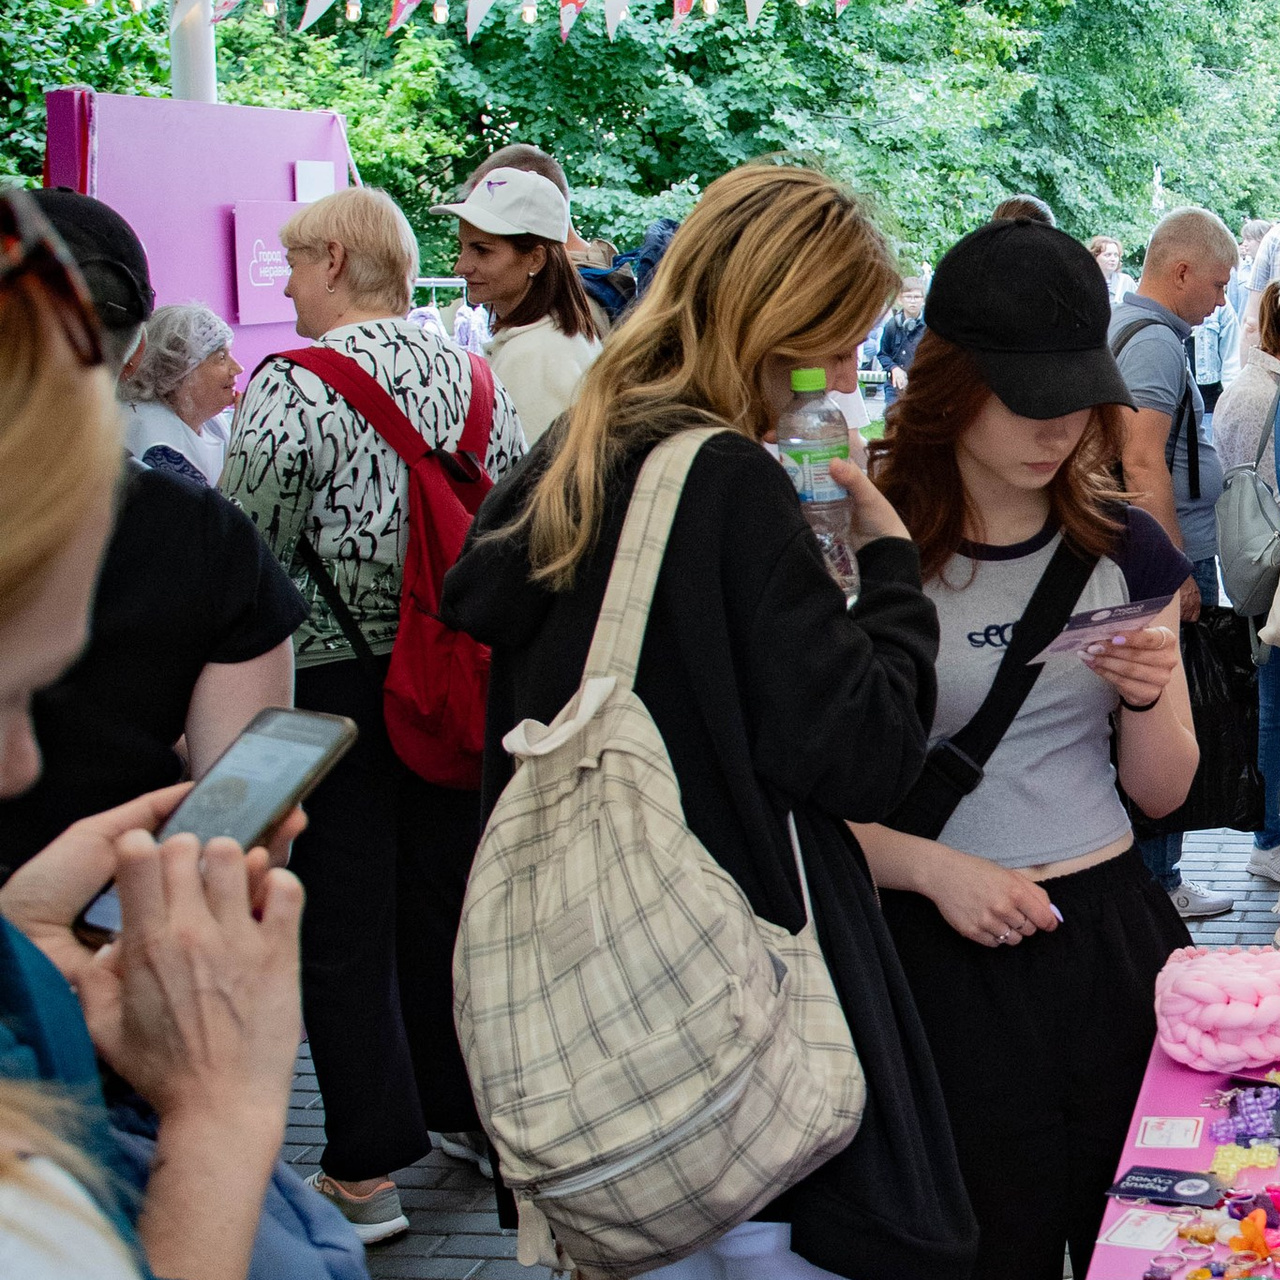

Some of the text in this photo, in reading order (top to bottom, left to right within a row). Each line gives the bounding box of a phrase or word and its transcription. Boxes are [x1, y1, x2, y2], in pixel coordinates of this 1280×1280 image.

[259, 250, 282, 264] город
[259, 265, 292, 280] неравно
[1120, 1181, 1169, 1193] Редкий
